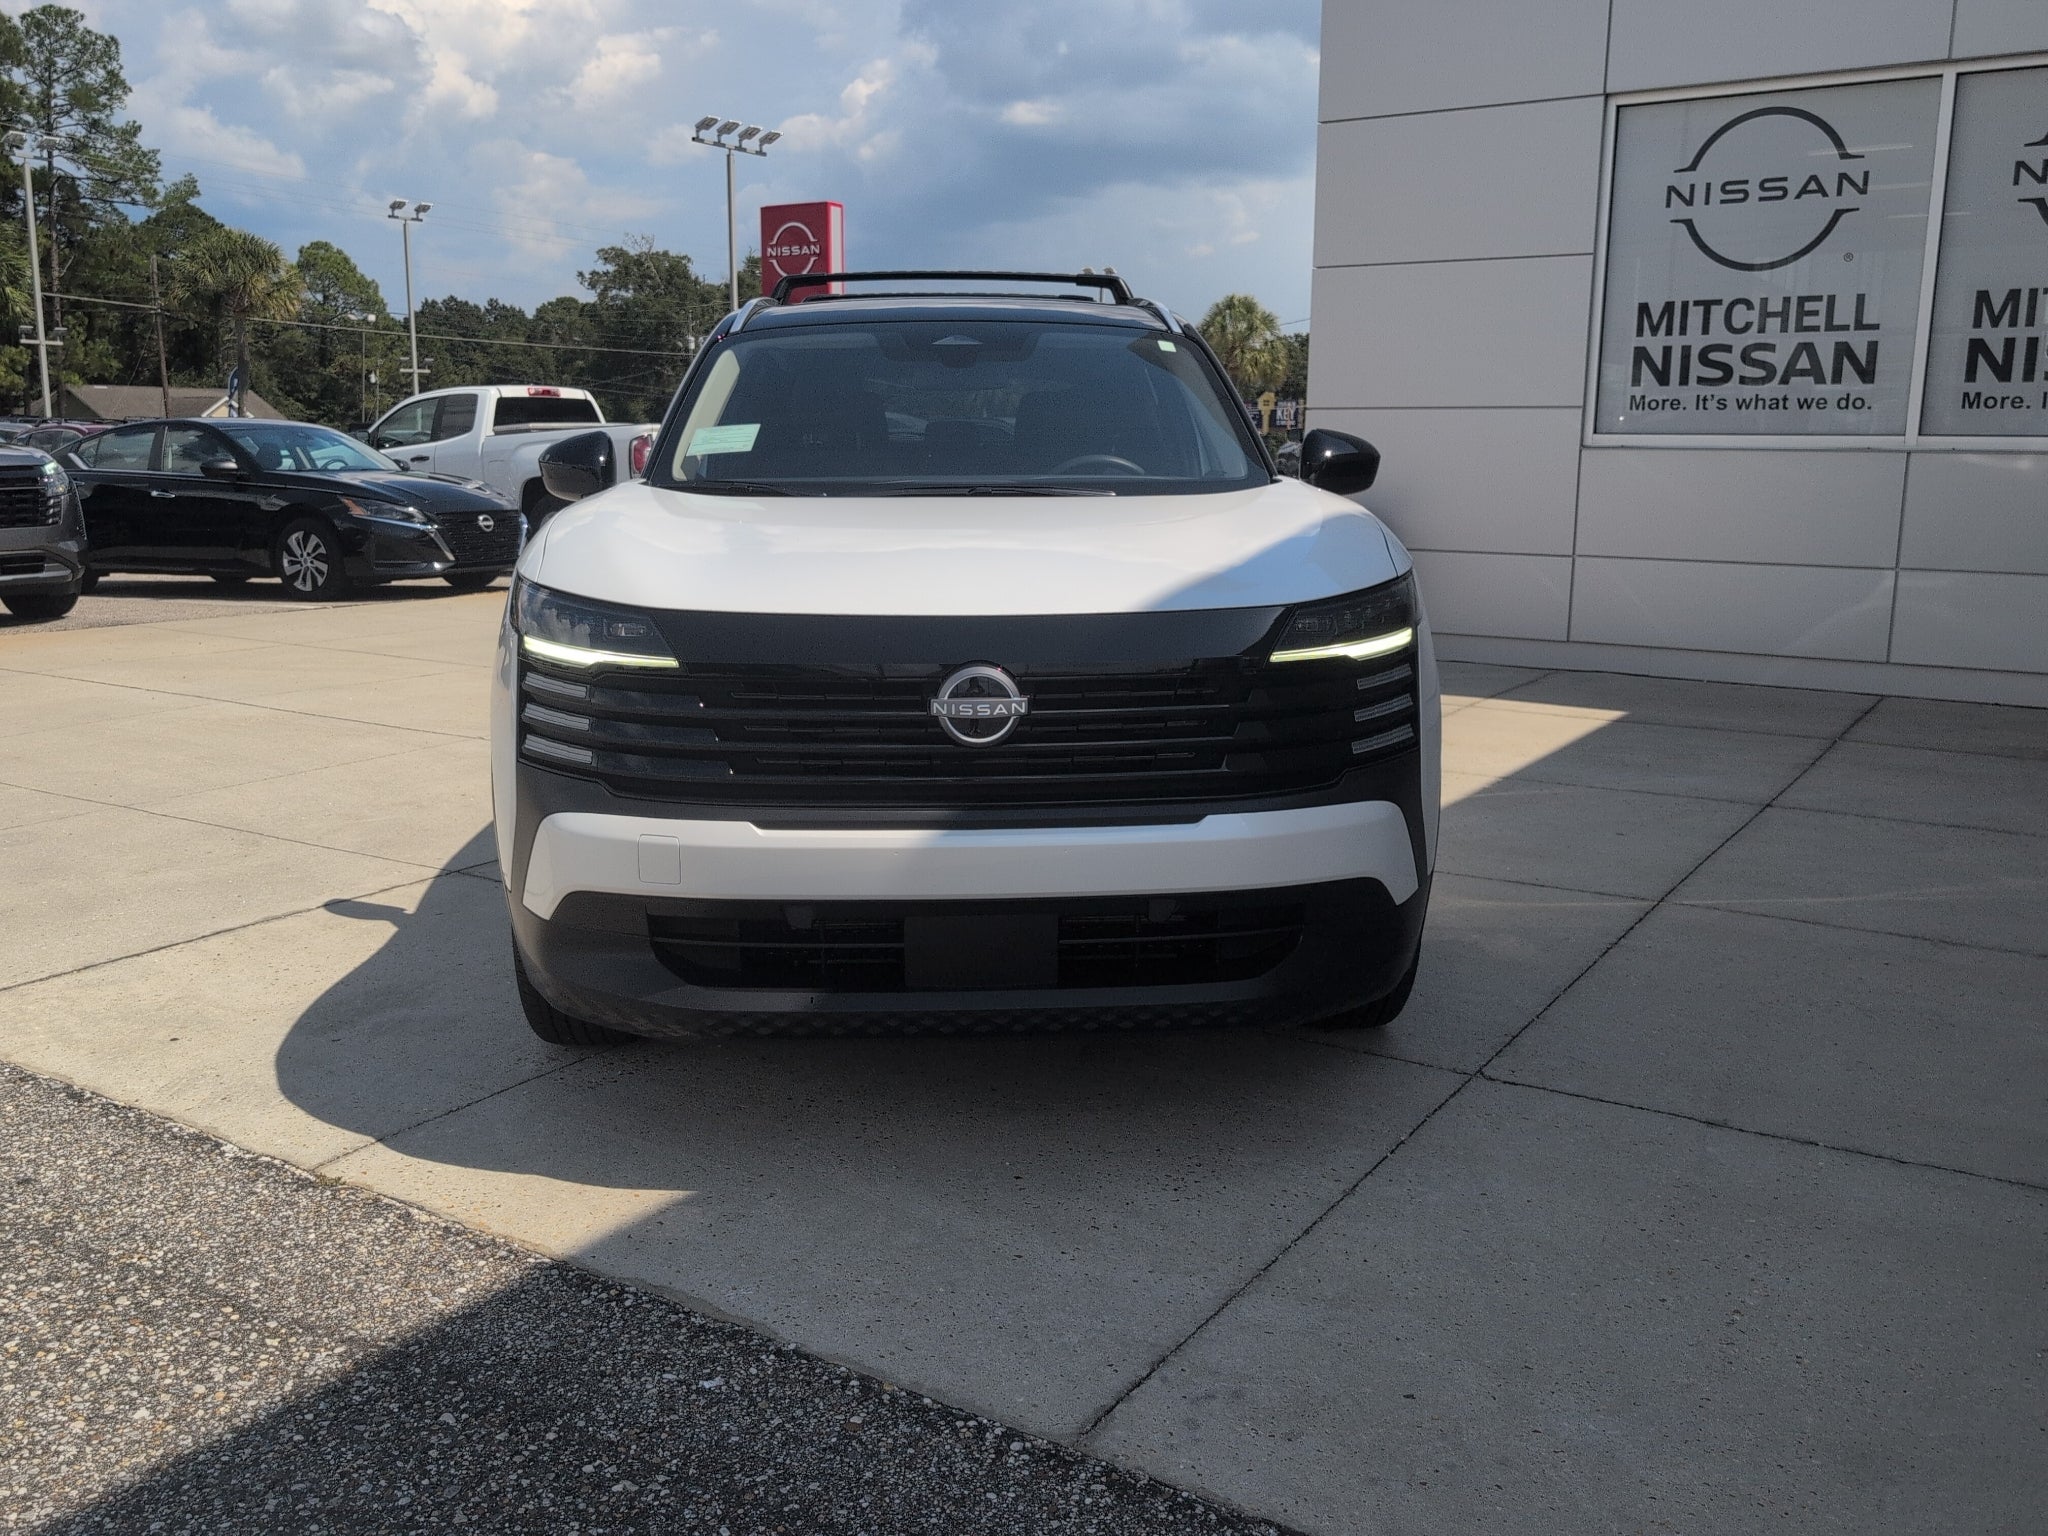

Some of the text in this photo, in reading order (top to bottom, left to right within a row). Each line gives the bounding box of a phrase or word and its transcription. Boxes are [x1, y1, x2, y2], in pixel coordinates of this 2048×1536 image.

[1665, 170, 1870, 208] NISSAN
[767, 244, 820, 257] NISSAN
[1635, 293, 1881, 337] MITCHELL
[1630, 340, 1879, 387] NISSAN
[1629, 392, 1873, 411] More. It's what we do.
[1961, 391, 2031, 409] More.
[933, 702, 1026, 716] NISSAN
